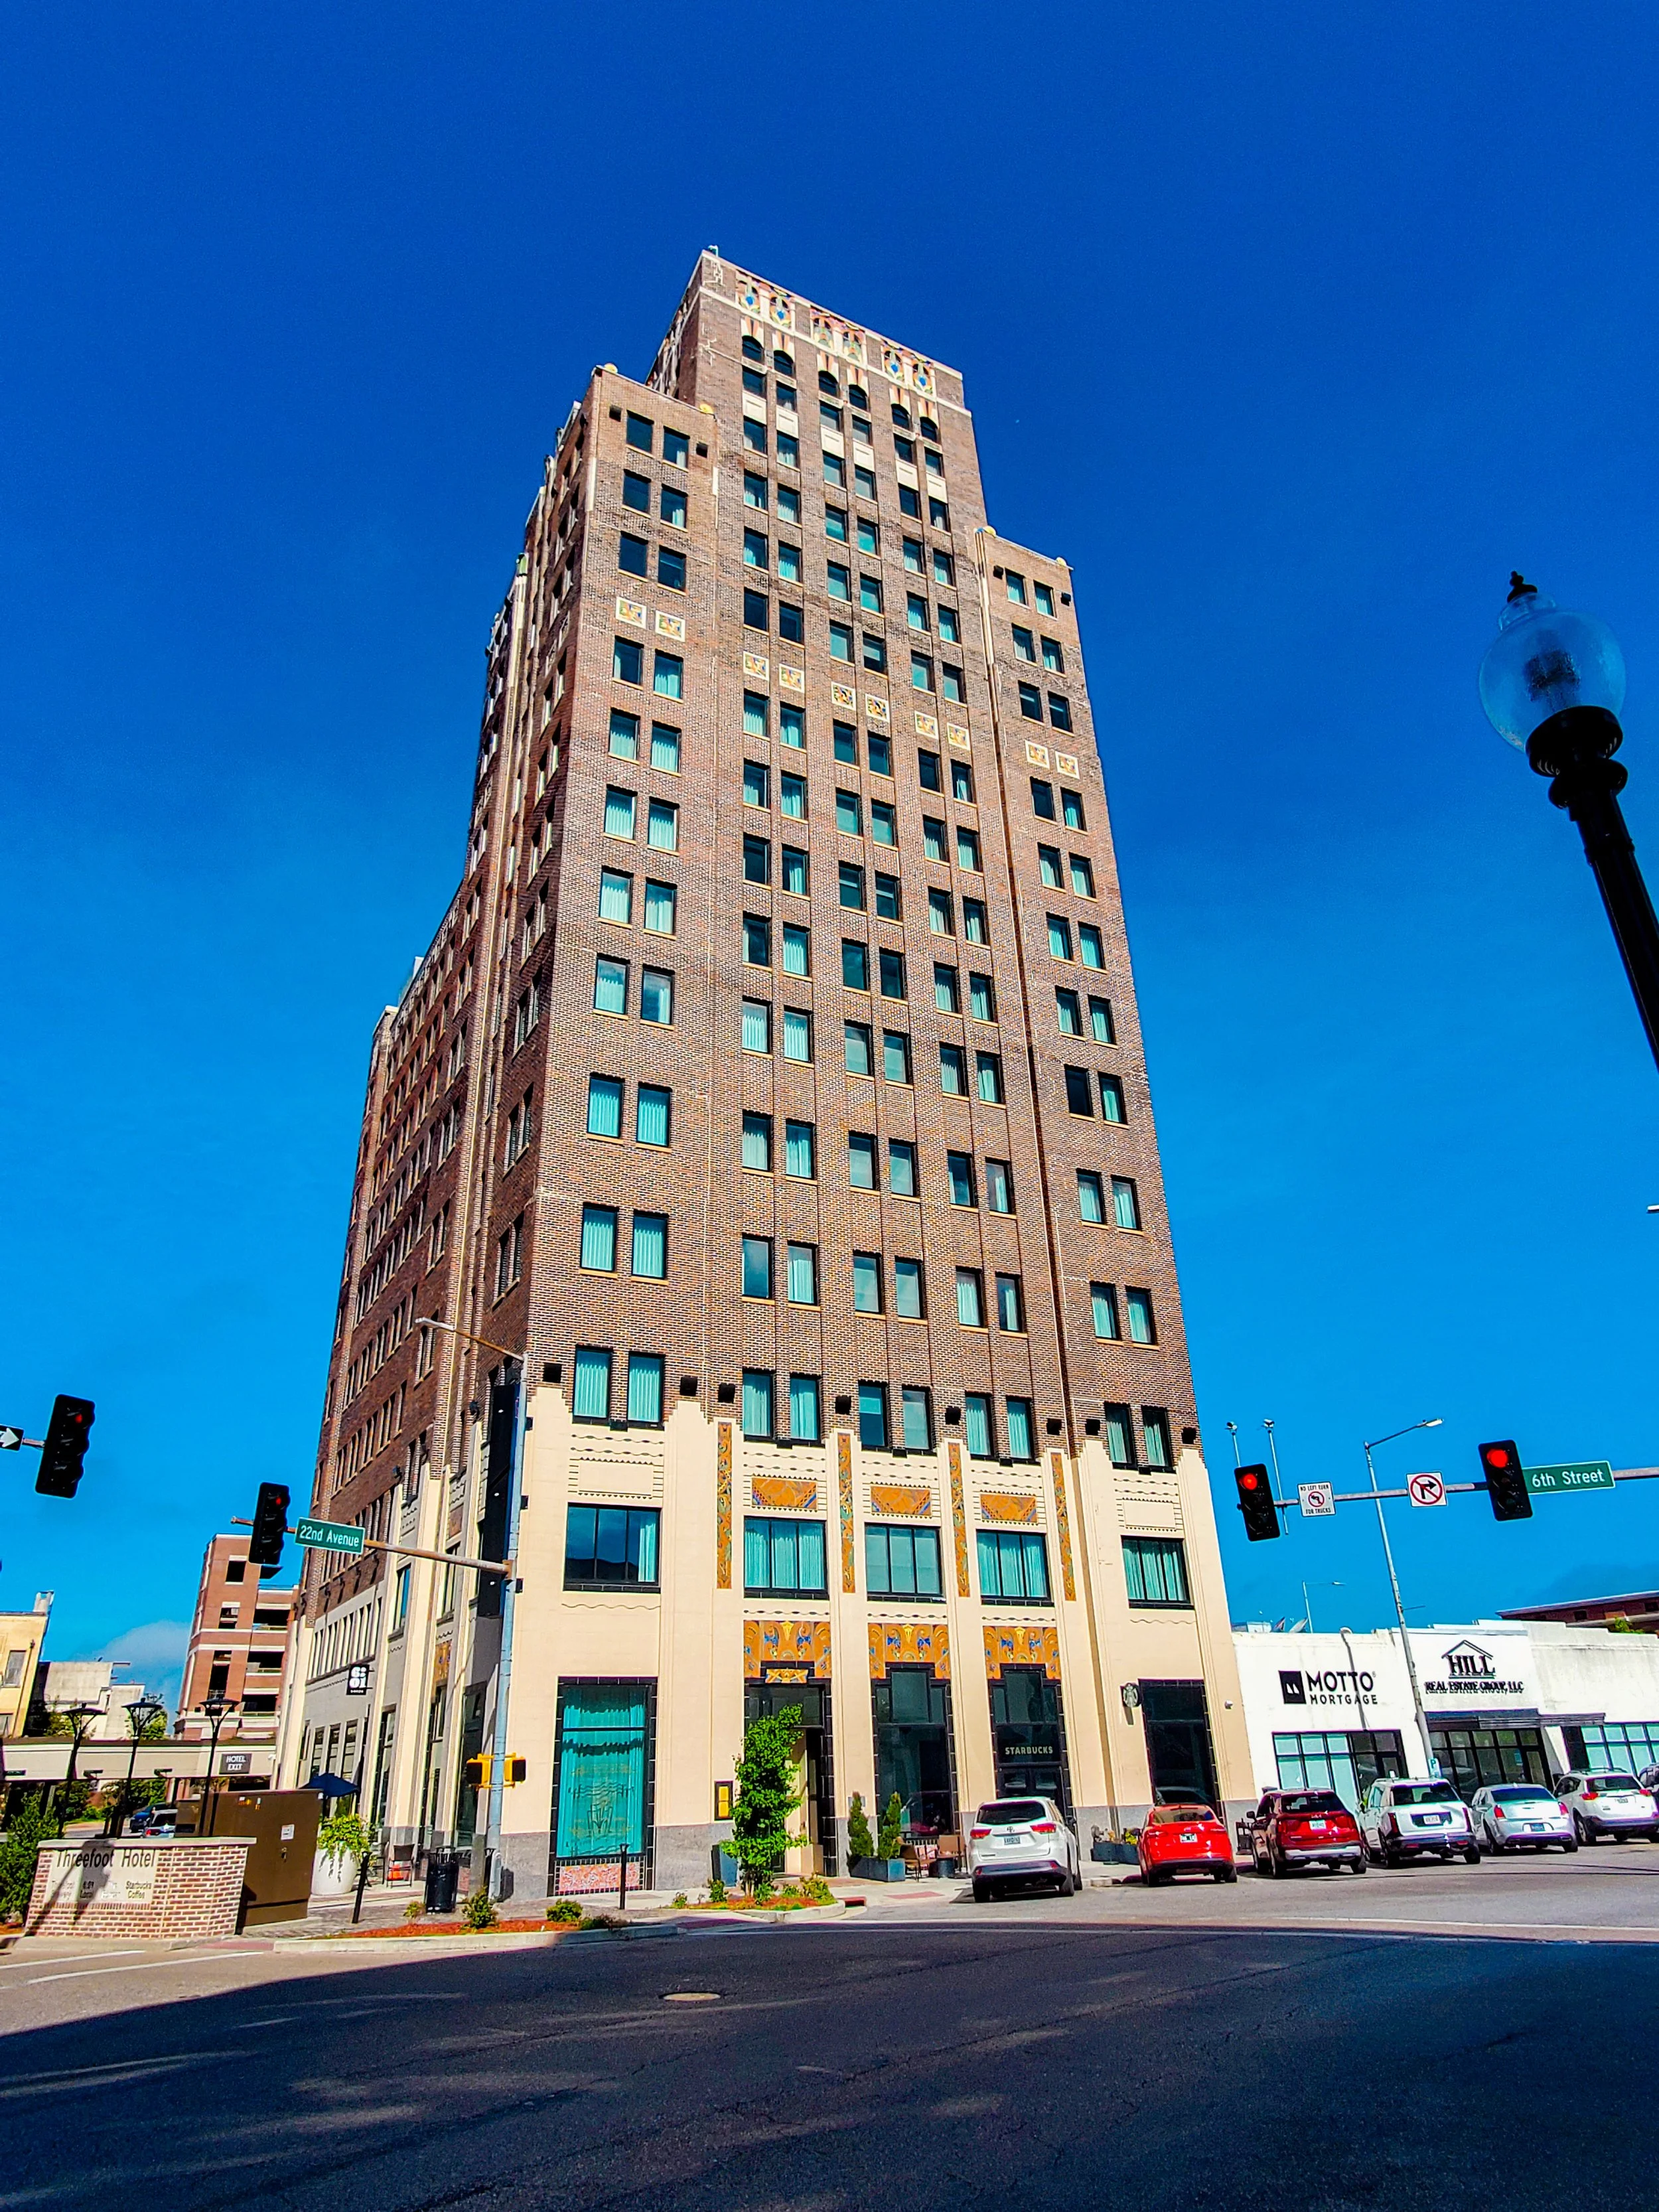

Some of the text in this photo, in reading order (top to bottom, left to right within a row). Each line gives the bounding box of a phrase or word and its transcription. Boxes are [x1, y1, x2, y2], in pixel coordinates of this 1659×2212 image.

[1532, 1468, 1605, 1487] 6th Street
[299, 1524, 360, 1547] 22nd Avenue
[1447, 1655, 1496, 1676] HILL
[1305, 1670, 1374, 1692] MOTTO
[1424, 1680, 1448, 1694] REAL
[1508, 1680, 1524, 1694] LLC
[1310, 1694, 1378, 1705] MORTGAGE
[226, 1755, 246, 1763] HOTEL
[1005, 1745, 1053, 1755] STARBUCKS
[56, 1848, 156, 1868] Threefoot Hotel
